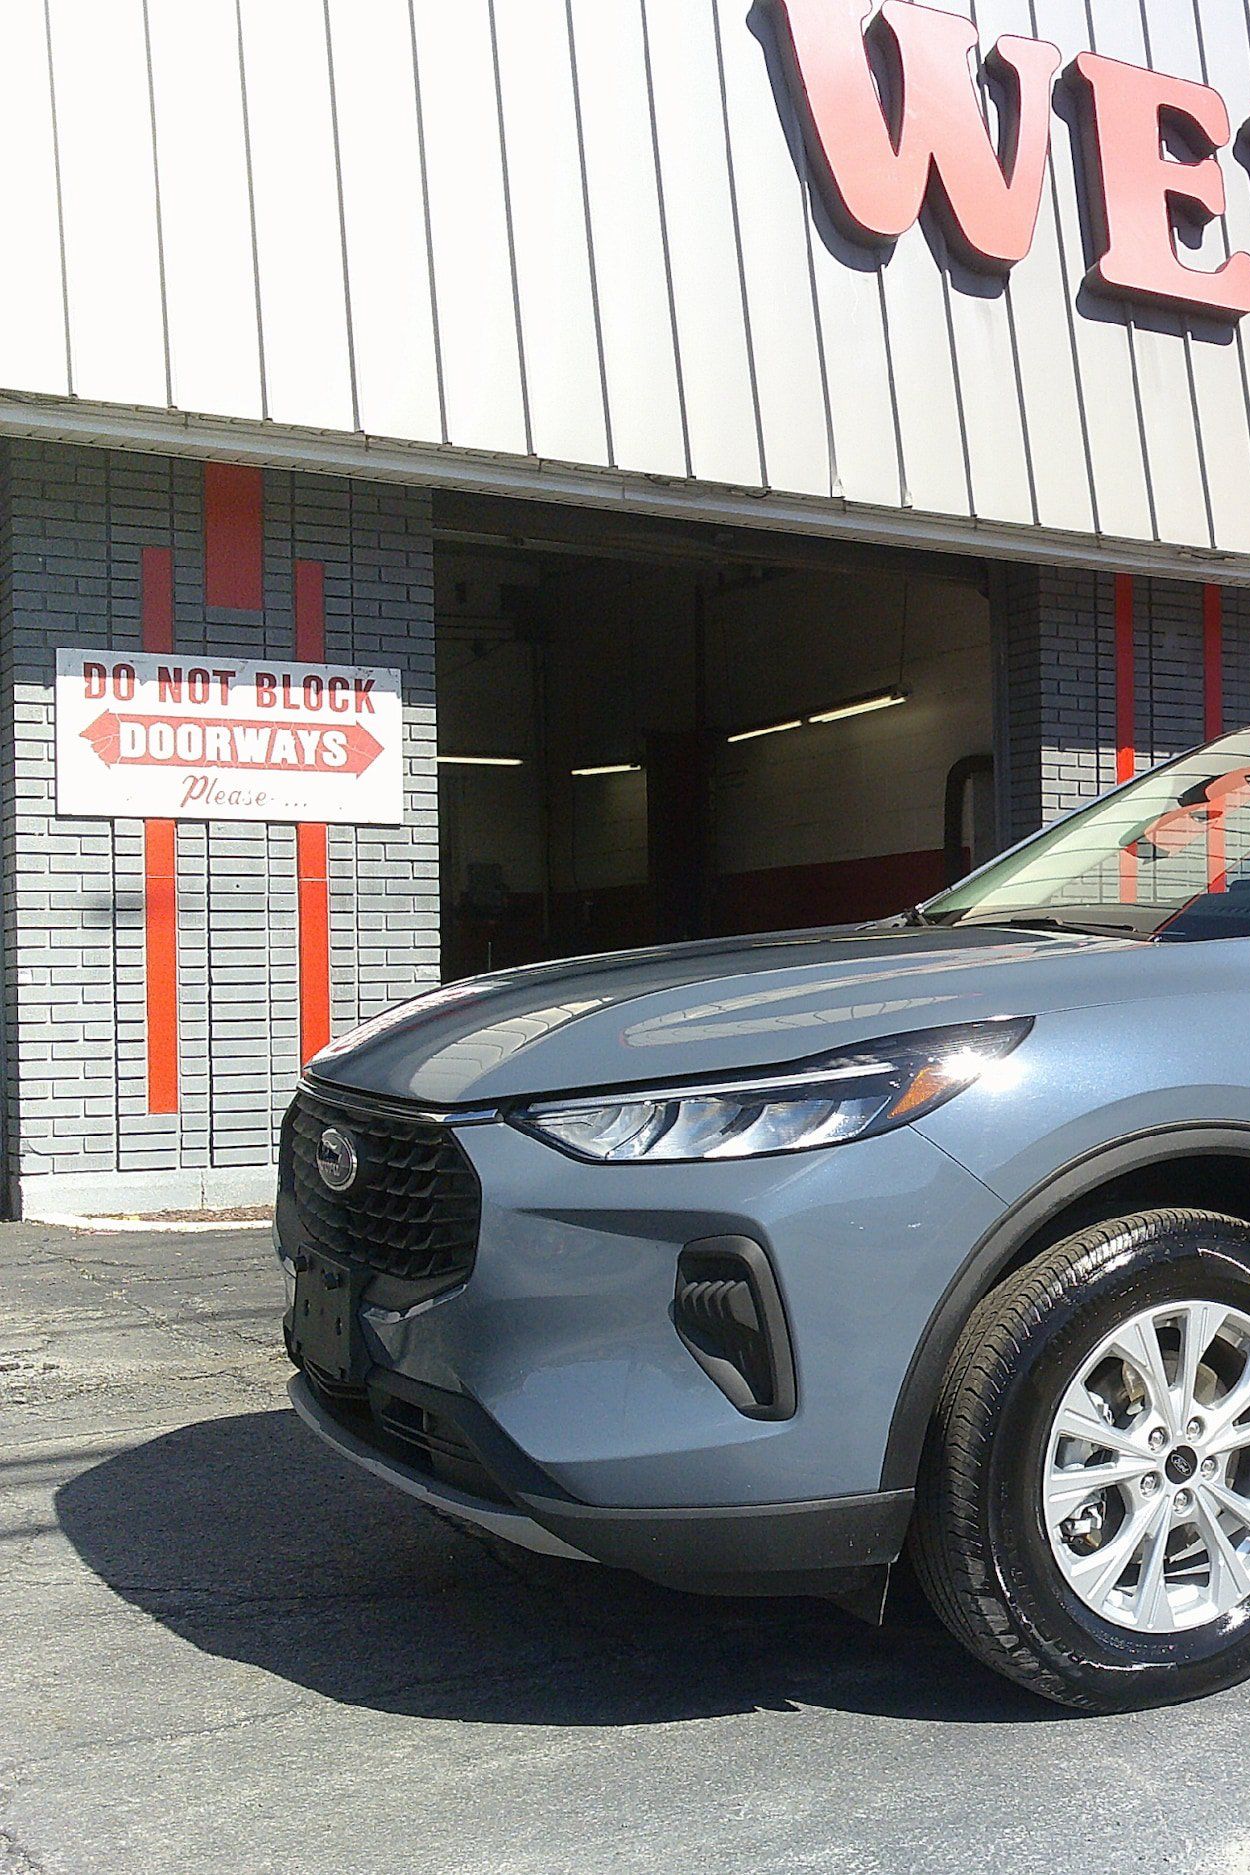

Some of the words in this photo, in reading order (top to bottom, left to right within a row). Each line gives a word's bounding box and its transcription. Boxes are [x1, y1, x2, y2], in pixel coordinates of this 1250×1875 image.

[83, 661, 136, 701] DO
[156, 666, 236, 706] NOT
[255, 671, 376, 714] BLOCK
[119, 721, 349, 768] DOORWAYS
[180, 775, 267, 808] Please
